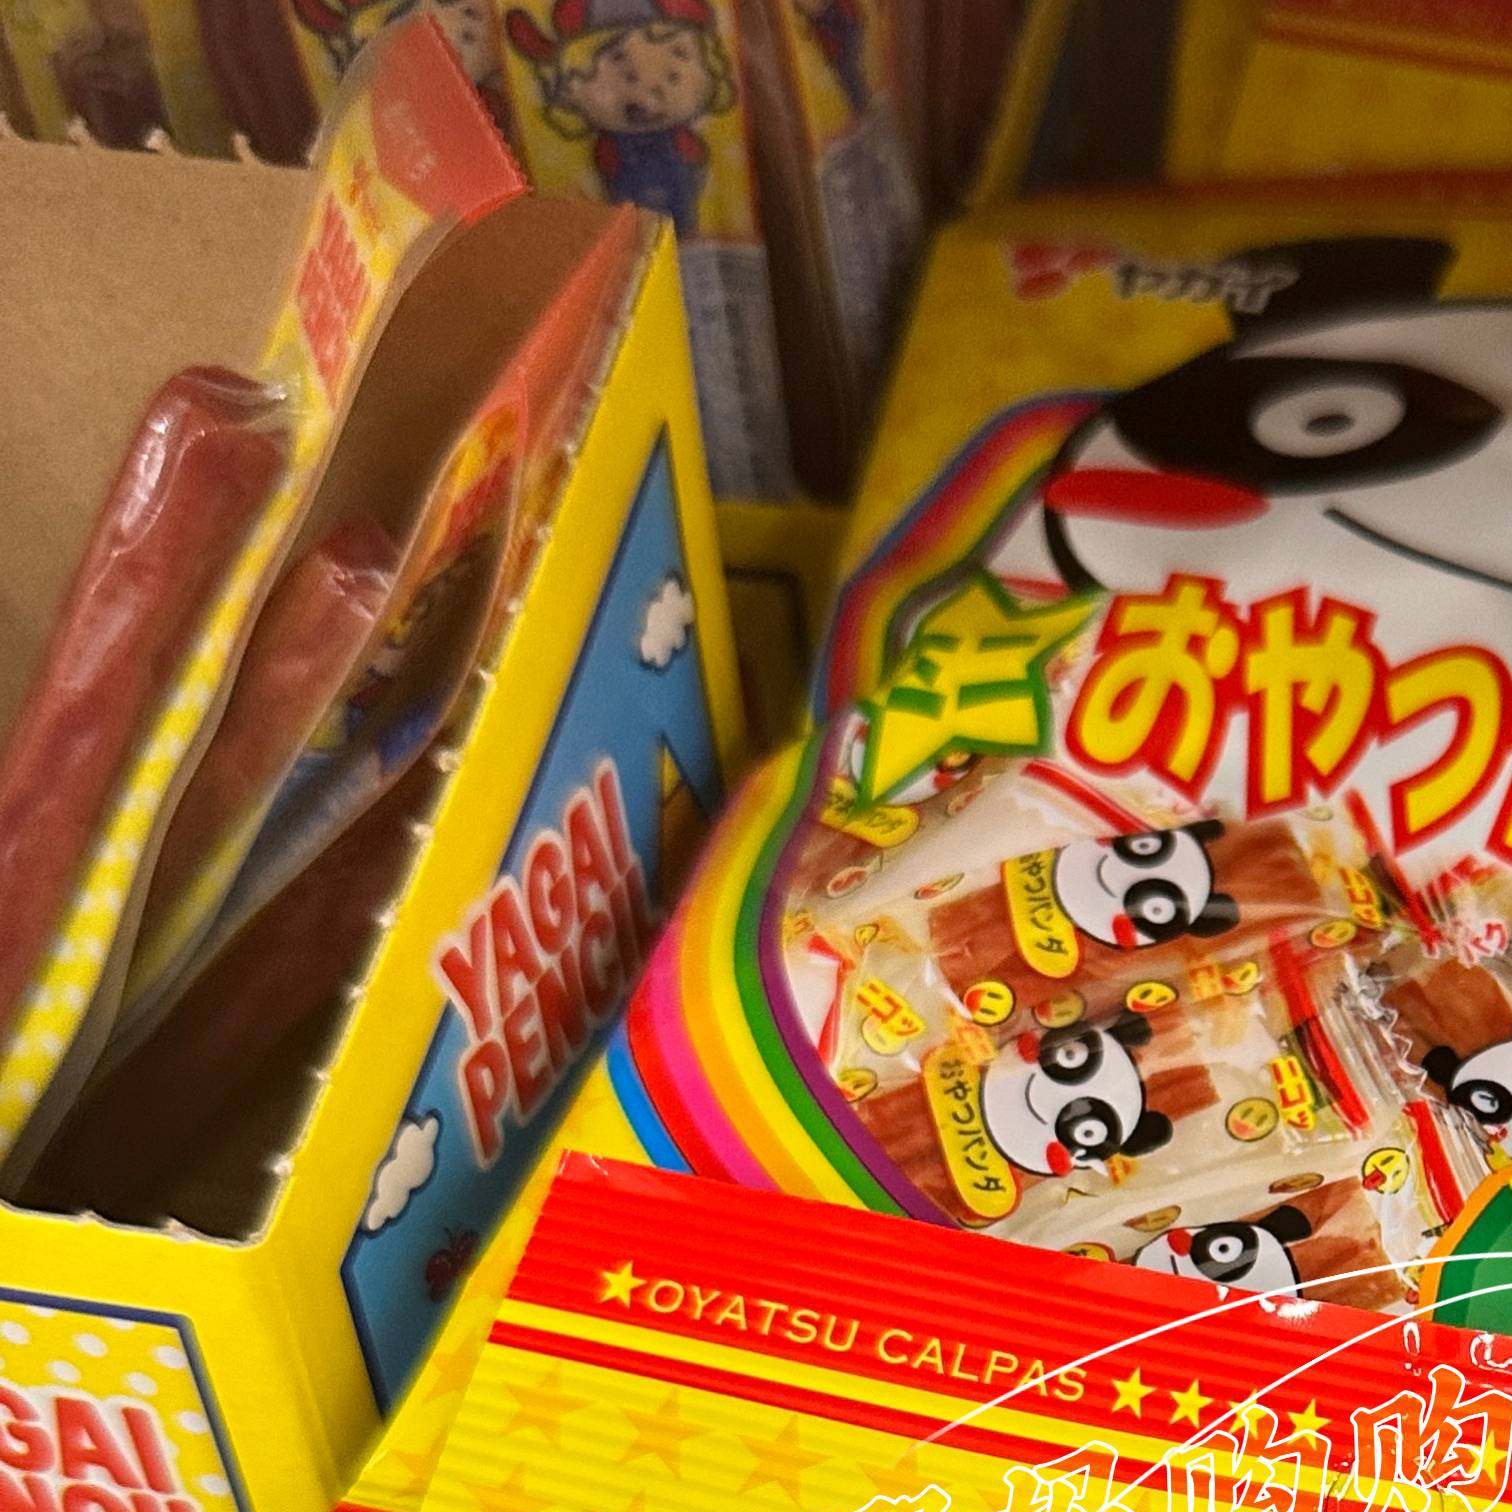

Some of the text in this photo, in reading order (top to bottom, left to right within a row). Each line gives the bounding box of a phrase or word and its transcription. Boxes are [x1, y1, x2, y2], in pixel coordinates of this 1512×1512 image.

[438, 766, 633, 1044] YAGAI
[940, 1060, 1008, 1194] おやつパンダ
[648, 1276, 1088, 1402] OYATSU CALPAS
